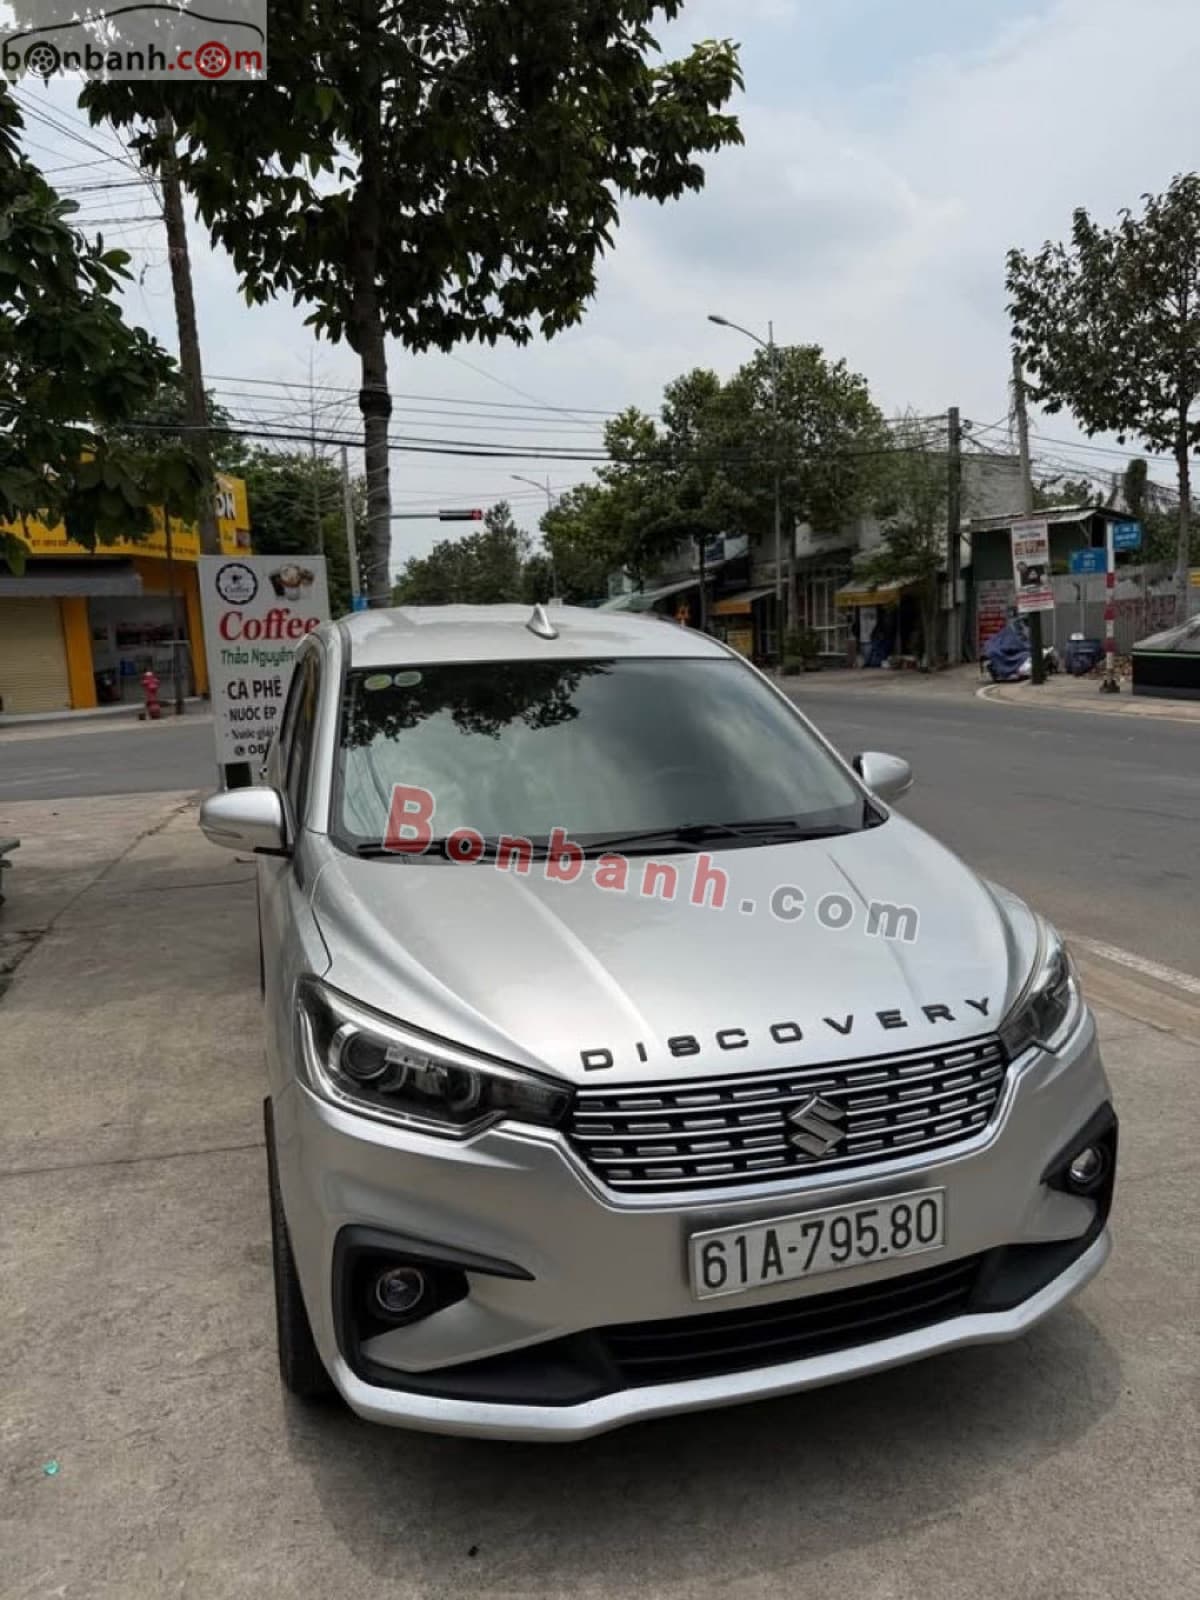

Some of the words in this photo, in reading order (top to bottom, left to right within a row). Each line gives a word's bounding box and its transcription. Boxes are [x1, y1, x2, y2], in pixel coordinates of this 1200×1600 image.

[219, 608, 321, 641] Coffee
[580, 997, 990, 1072] DISCOVERY
[702, 1198, 938, 1289] 61A-795.80
